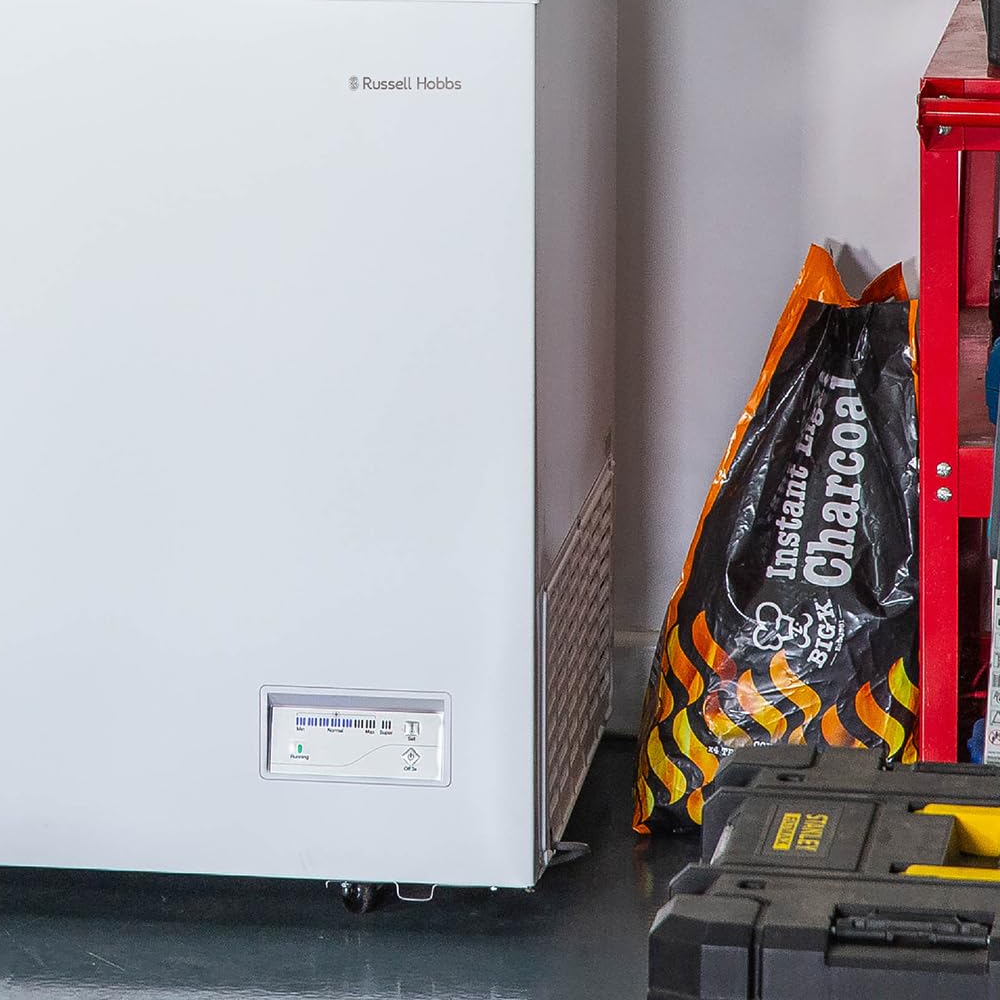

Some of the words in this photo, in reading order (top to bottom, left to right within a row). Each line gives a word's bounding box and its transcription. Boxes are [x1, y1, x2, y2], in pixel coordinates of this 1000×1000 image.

[362, 76, 412, 90] Russell
[416, 76, 462, 90] Hobbs
[766, 463, 809, 580] Instant
[803, 375, 868, 588] Charcoal
